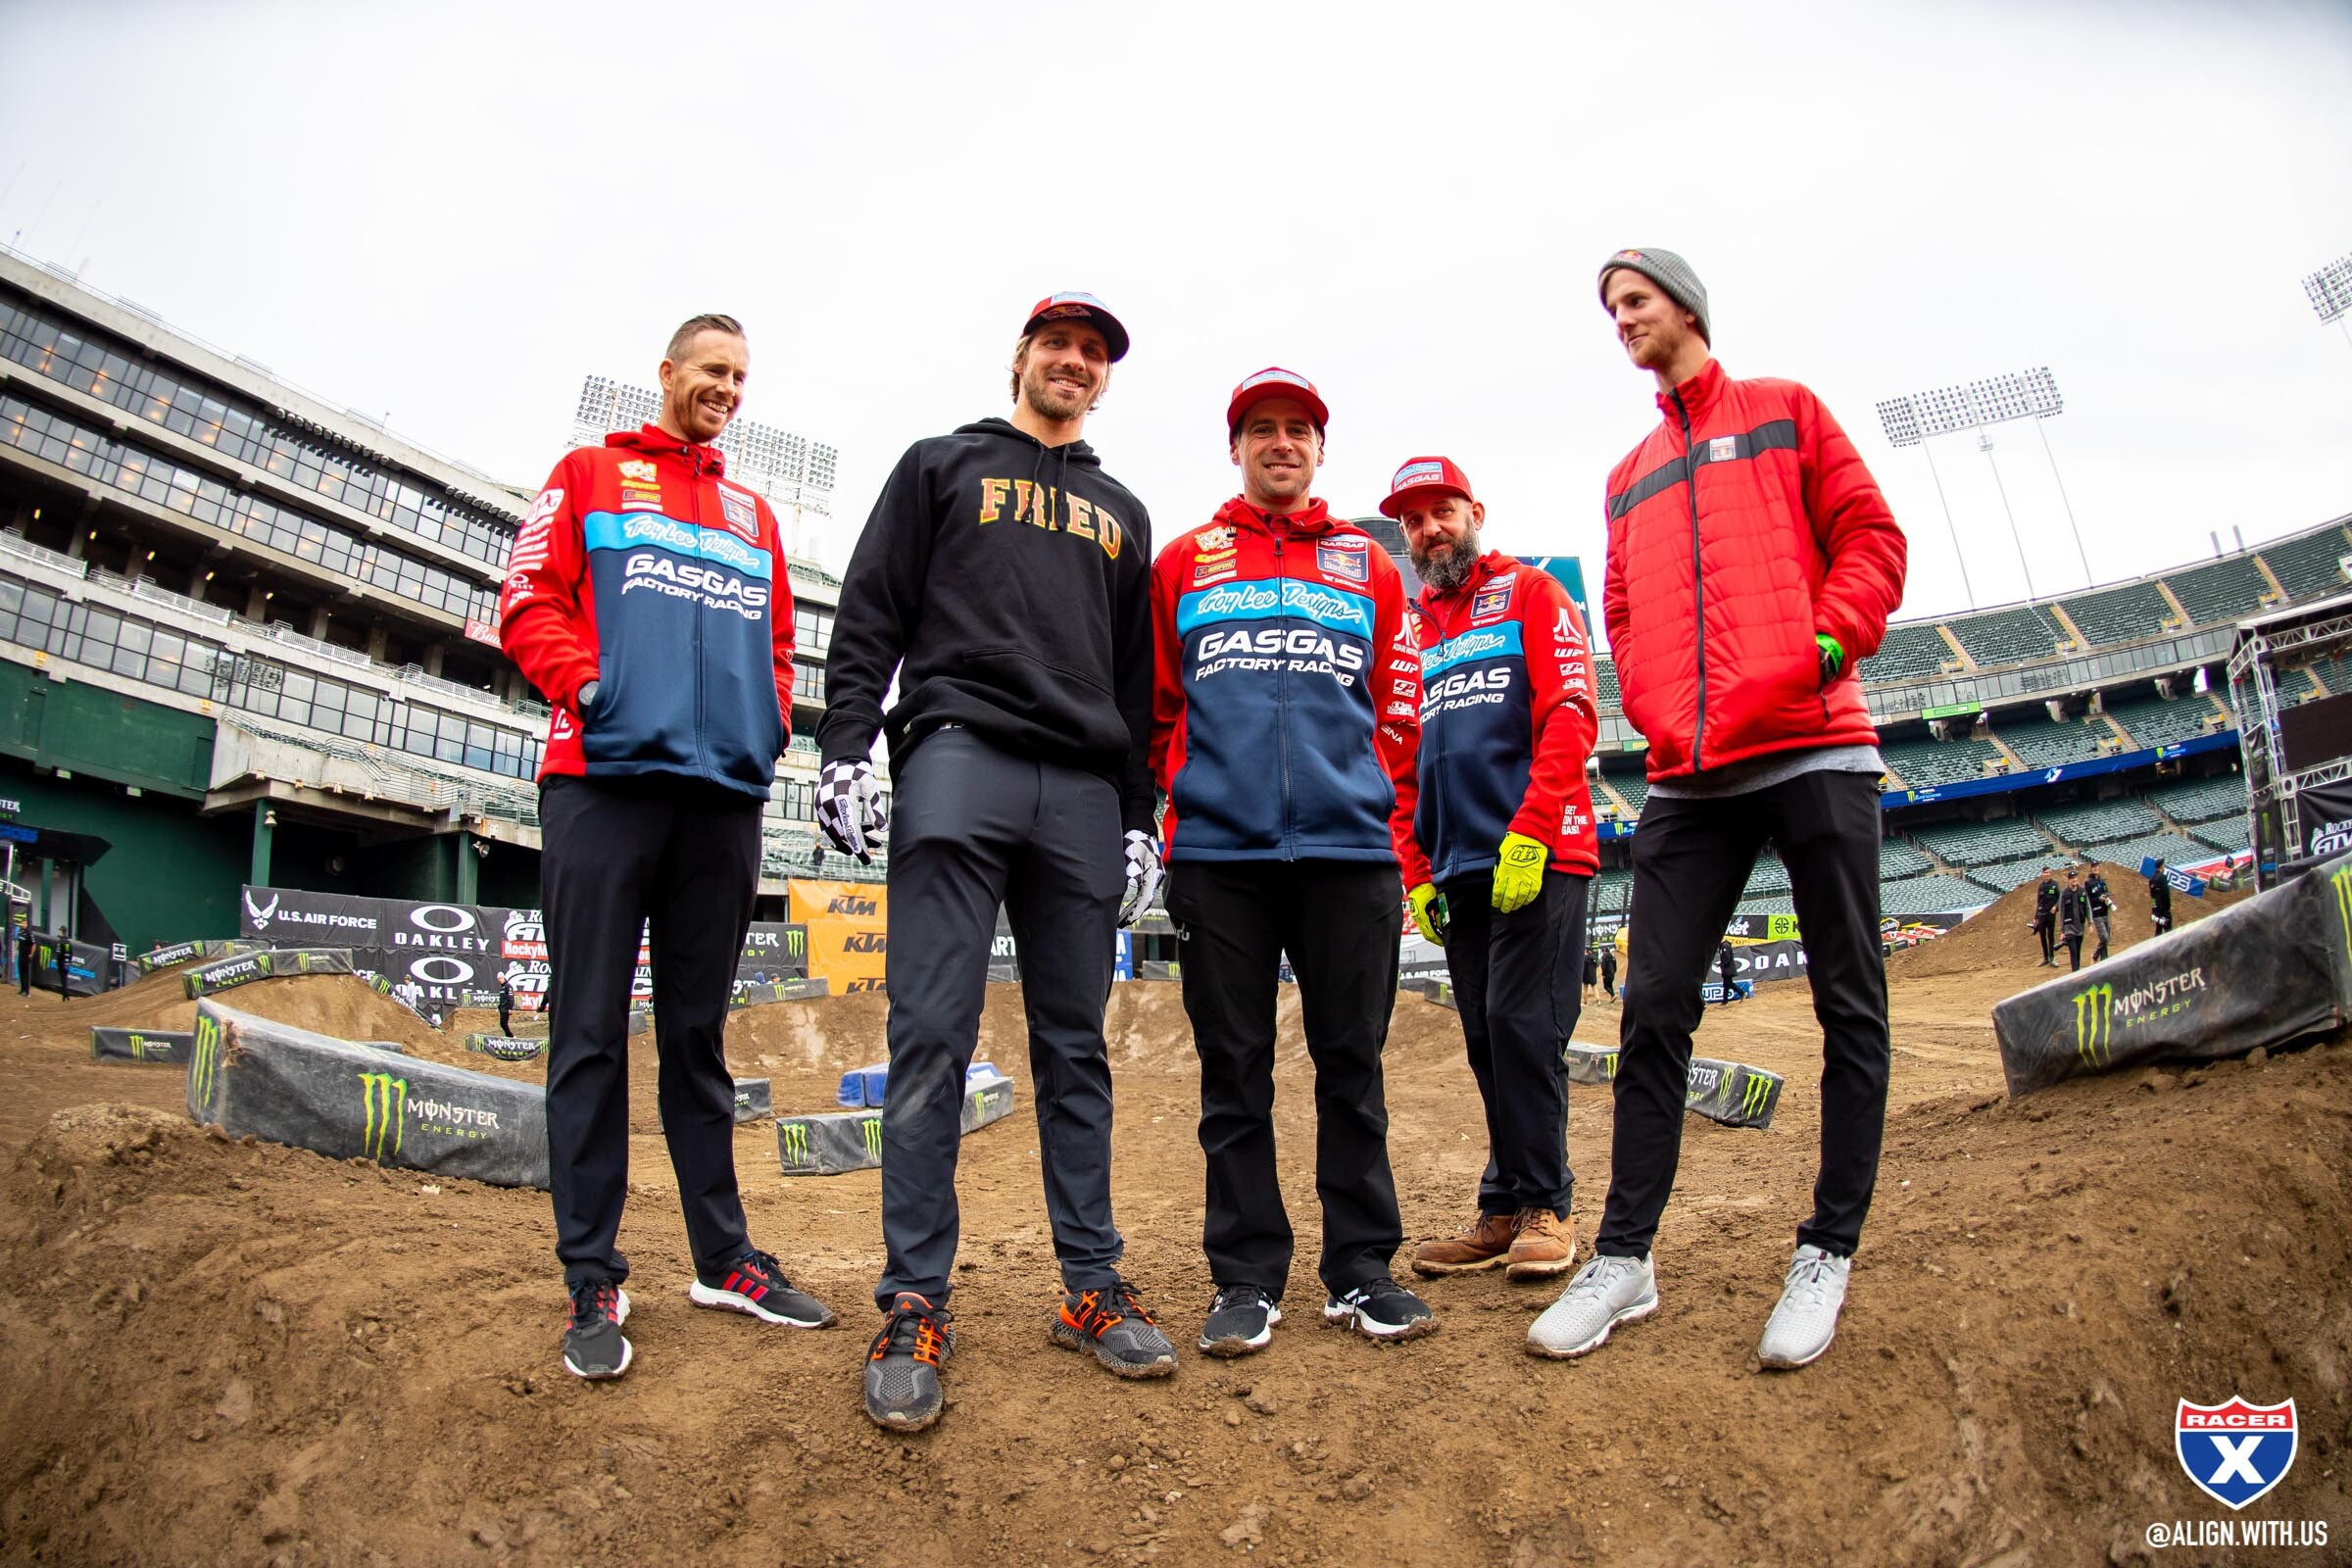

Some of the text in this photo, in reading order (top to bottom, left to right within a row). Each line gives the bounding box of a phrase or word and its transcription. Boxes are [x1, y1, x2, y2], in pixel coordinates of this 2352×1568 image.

[980, 478, 1122, 560] FRIED
[623, 515, 663, 540] Troy
[663, 522, 698, 548] Lee
[699, 530, 760, 568] Designs
[625, 554, 768, 607] GASGAS
[621, 576, 762, 620] FACTORY RACING
[1197, 583, 1363, 624] Troy Lee Designs
[1198, 628, 1364, 670] GASGAS
[1553, 648, 1585, 658] WP
[1195, 658, 1355, 687] FACTORY RACING
[1389, 659, 1419, 674] WP
[1419, 667, 1511, 710] ASGAS
[1444, 693, 1505, 711] RACING
[1573, 815, 1588, 825] THE
[827, 895, 877, 916] KTM
[277, 909, 377, 929] U.S. AIR FORCE
[394, 932, 490, 952] OAKLEY
[153, 946, 194, 963] MONSTER
[205, 959, 257, 982] MONSTER
[1430, 968, 1450, 977] FOR
[2114, 967, 2206, 1015] MONSTER
[2126, 999, 2191, 1027] ENERGY
[489, 1039, 536, 1051] MONSTER
[407, 1098, 501, 1130] MONSTER
[420, 1123, 487, 1140] ENERGY
